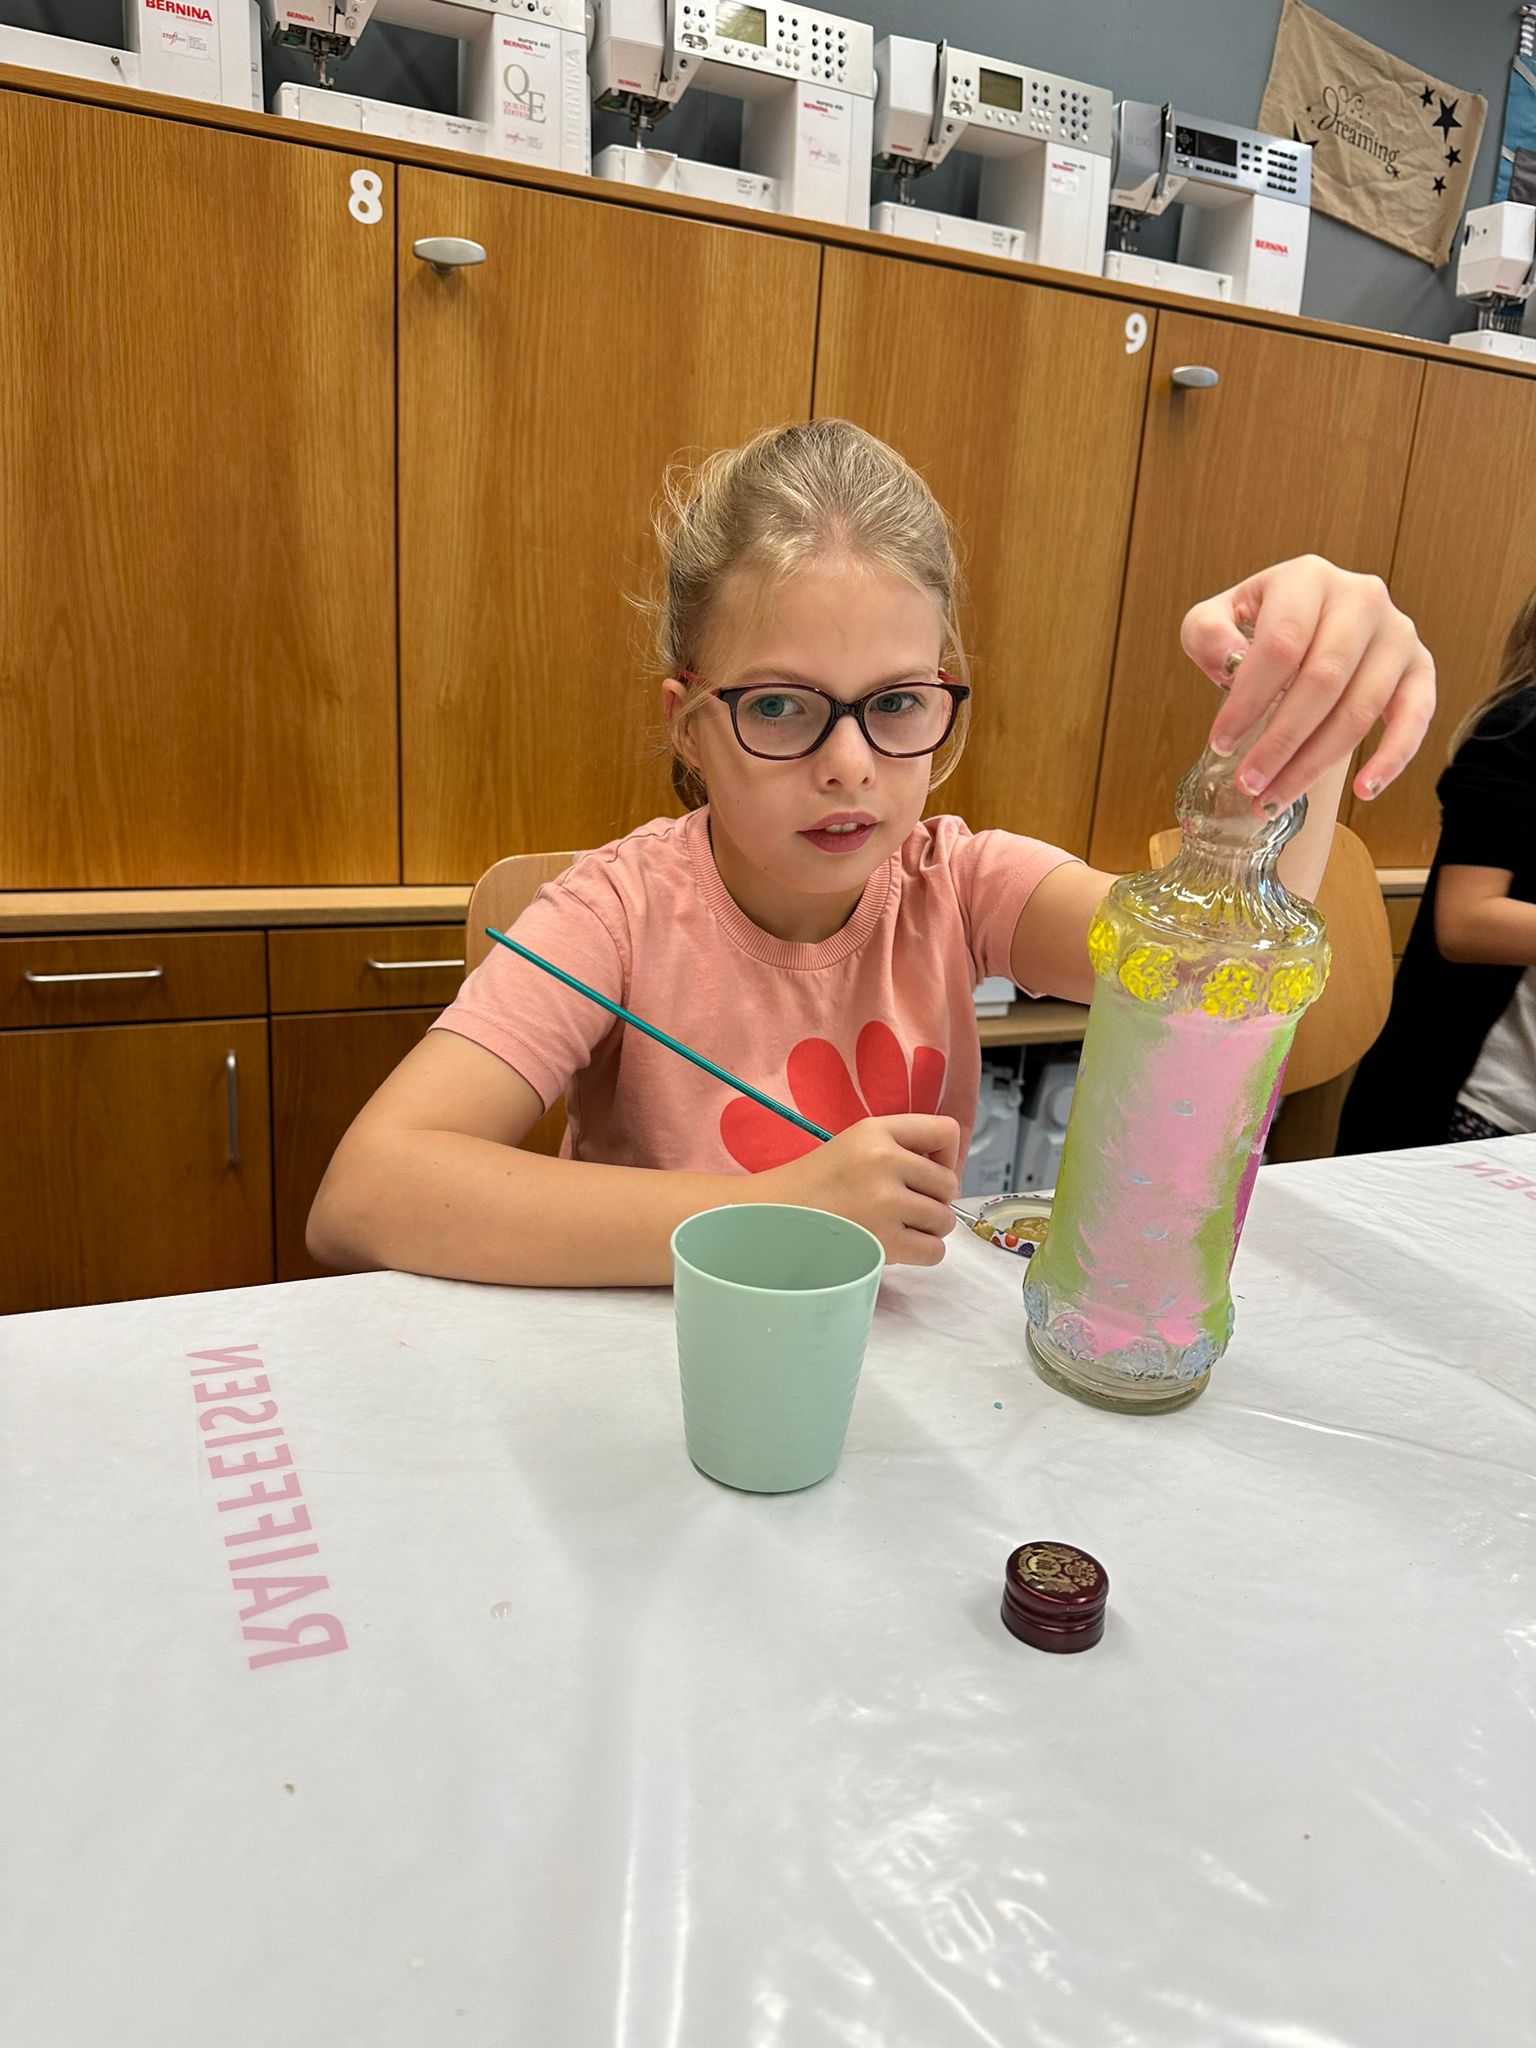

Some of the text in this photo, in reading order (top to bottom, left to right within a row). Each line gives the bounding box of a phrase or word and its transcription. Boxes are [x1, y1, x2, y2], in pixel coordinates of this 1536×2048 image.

[145, 0, 213, 22] BERNINA
[286, 11, 315, 22] BERNINA
[503, 39, 533, 52] BERNINA
[348, 169, 384, 225] 8
[1255, 239, 1289, 254] BERNINA
[1124, 312, 1149, 355] 9
